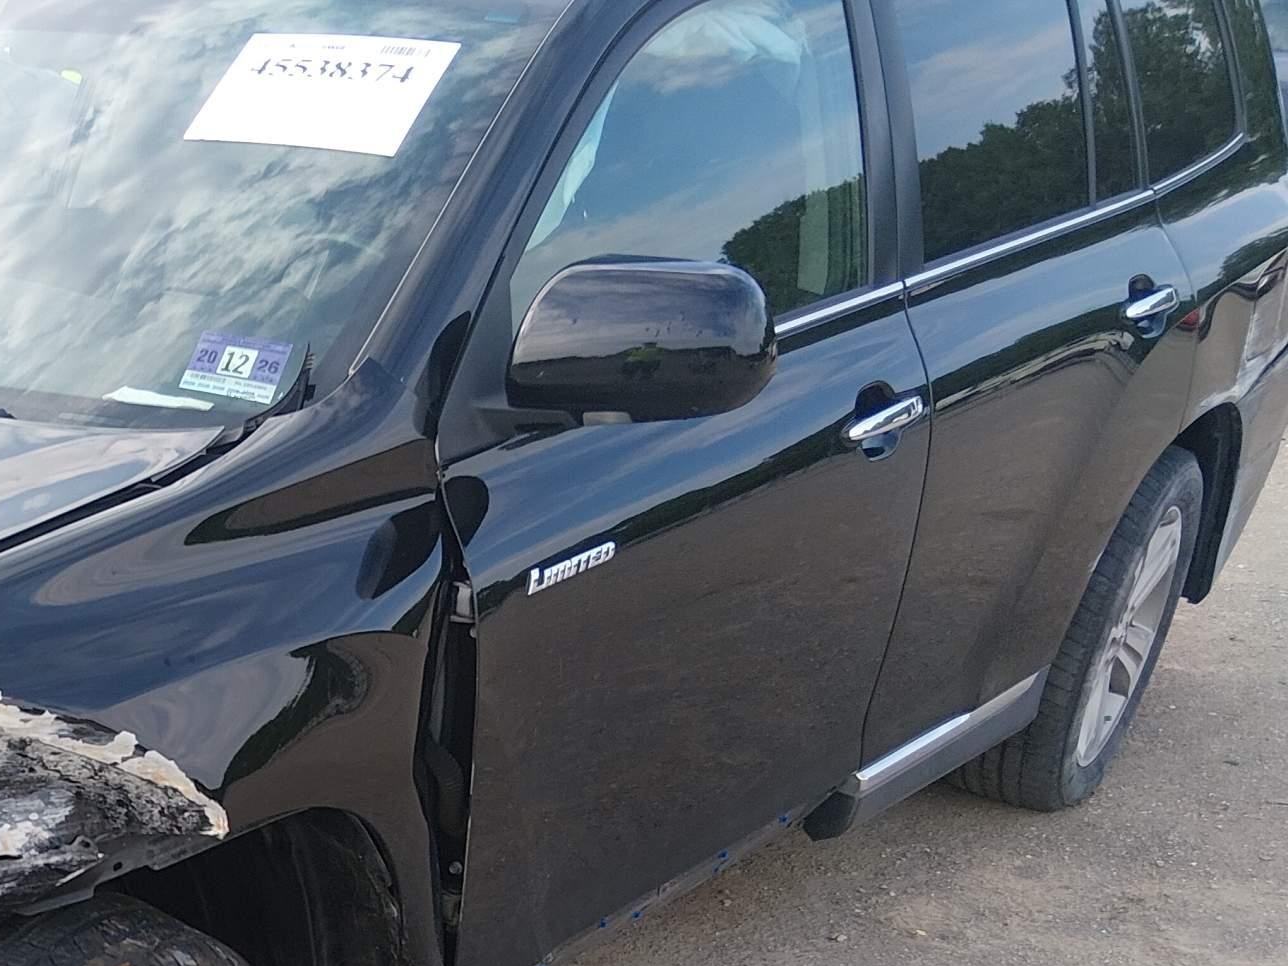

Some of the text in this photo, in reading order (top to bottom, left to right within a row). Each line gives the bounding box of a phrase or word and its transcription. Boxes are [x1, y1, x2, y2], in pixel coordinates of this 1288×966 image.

[251, 58, 414, 83] 45538374
[196, 348, 280, 374] 20 12 26
